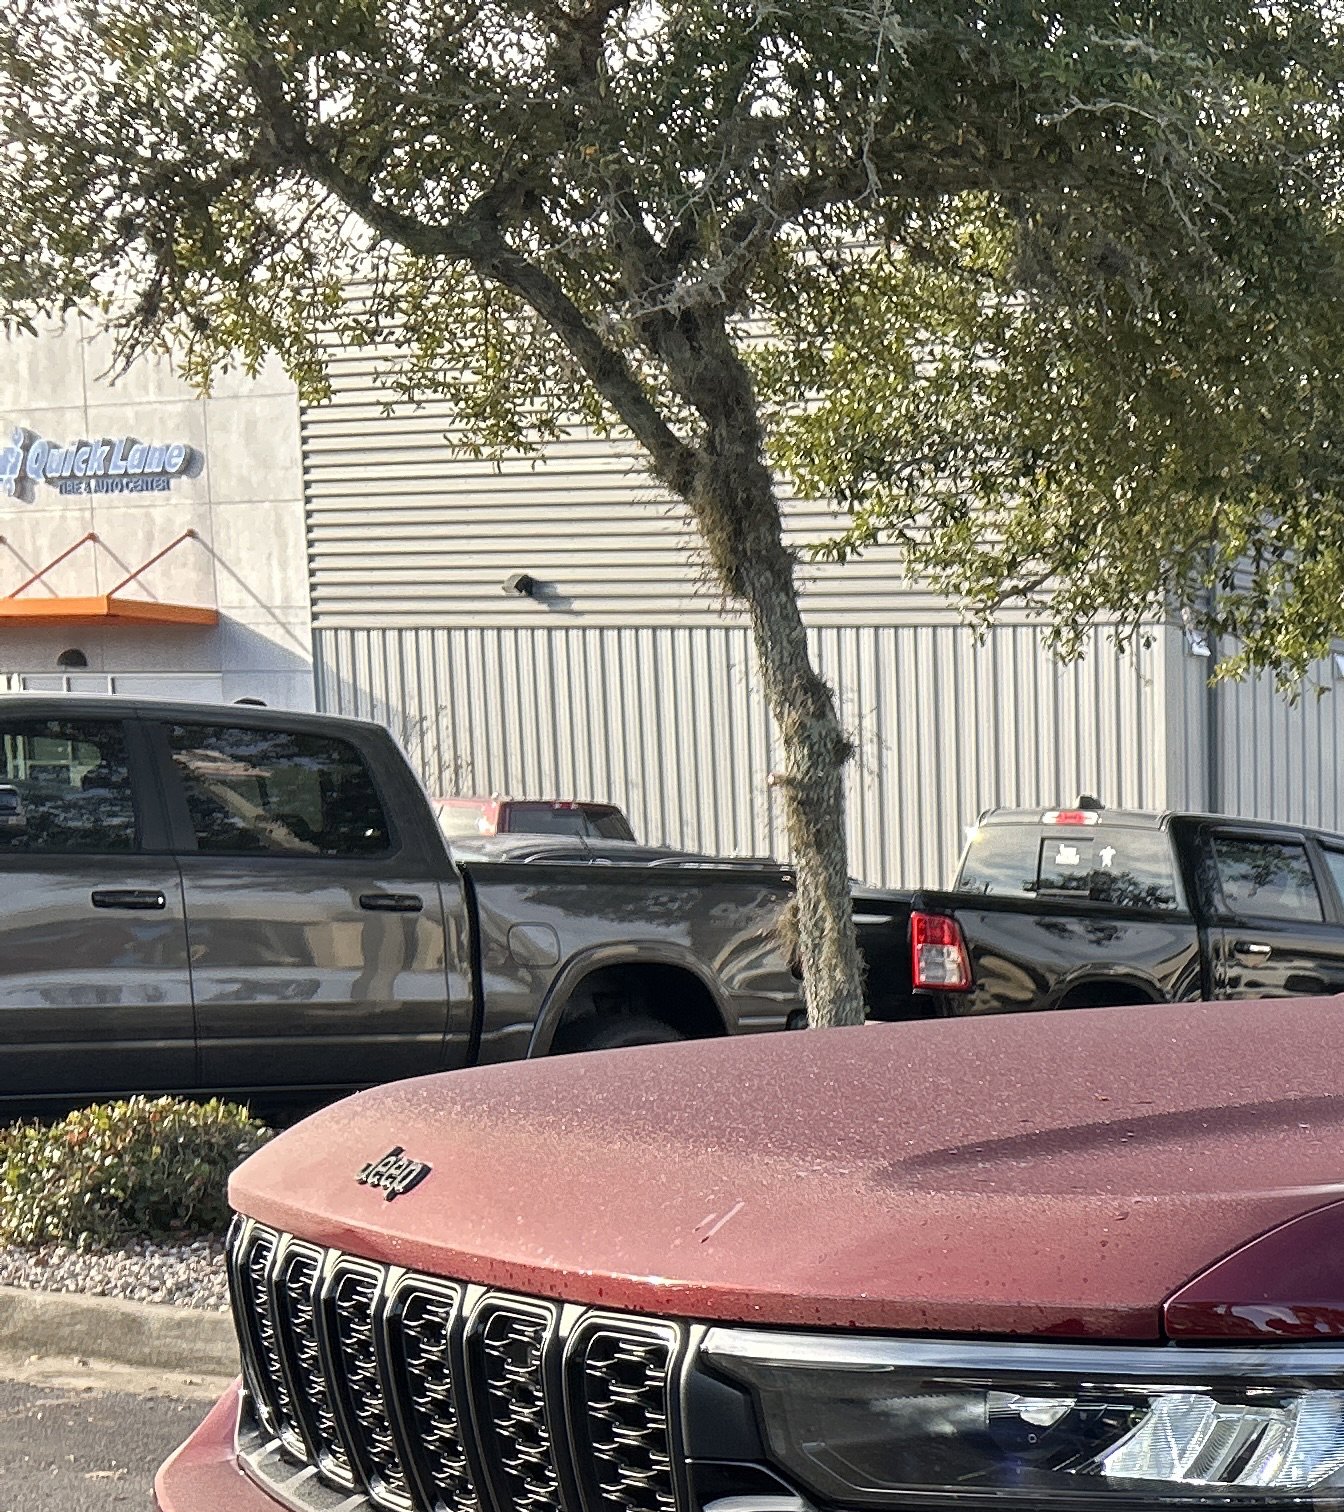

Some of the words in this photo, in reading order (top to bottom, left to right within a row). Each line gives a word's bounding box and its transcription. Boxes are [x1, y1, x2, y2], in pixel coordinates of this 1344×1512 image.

[26, 438, 111, 481] Quick
[108, 437, 187, 475] Lane
[93, 478, 124, 494] AUTO
[125, 477, 172, 492] CENTER
[356, 1146, 433, 1202] Jeep
